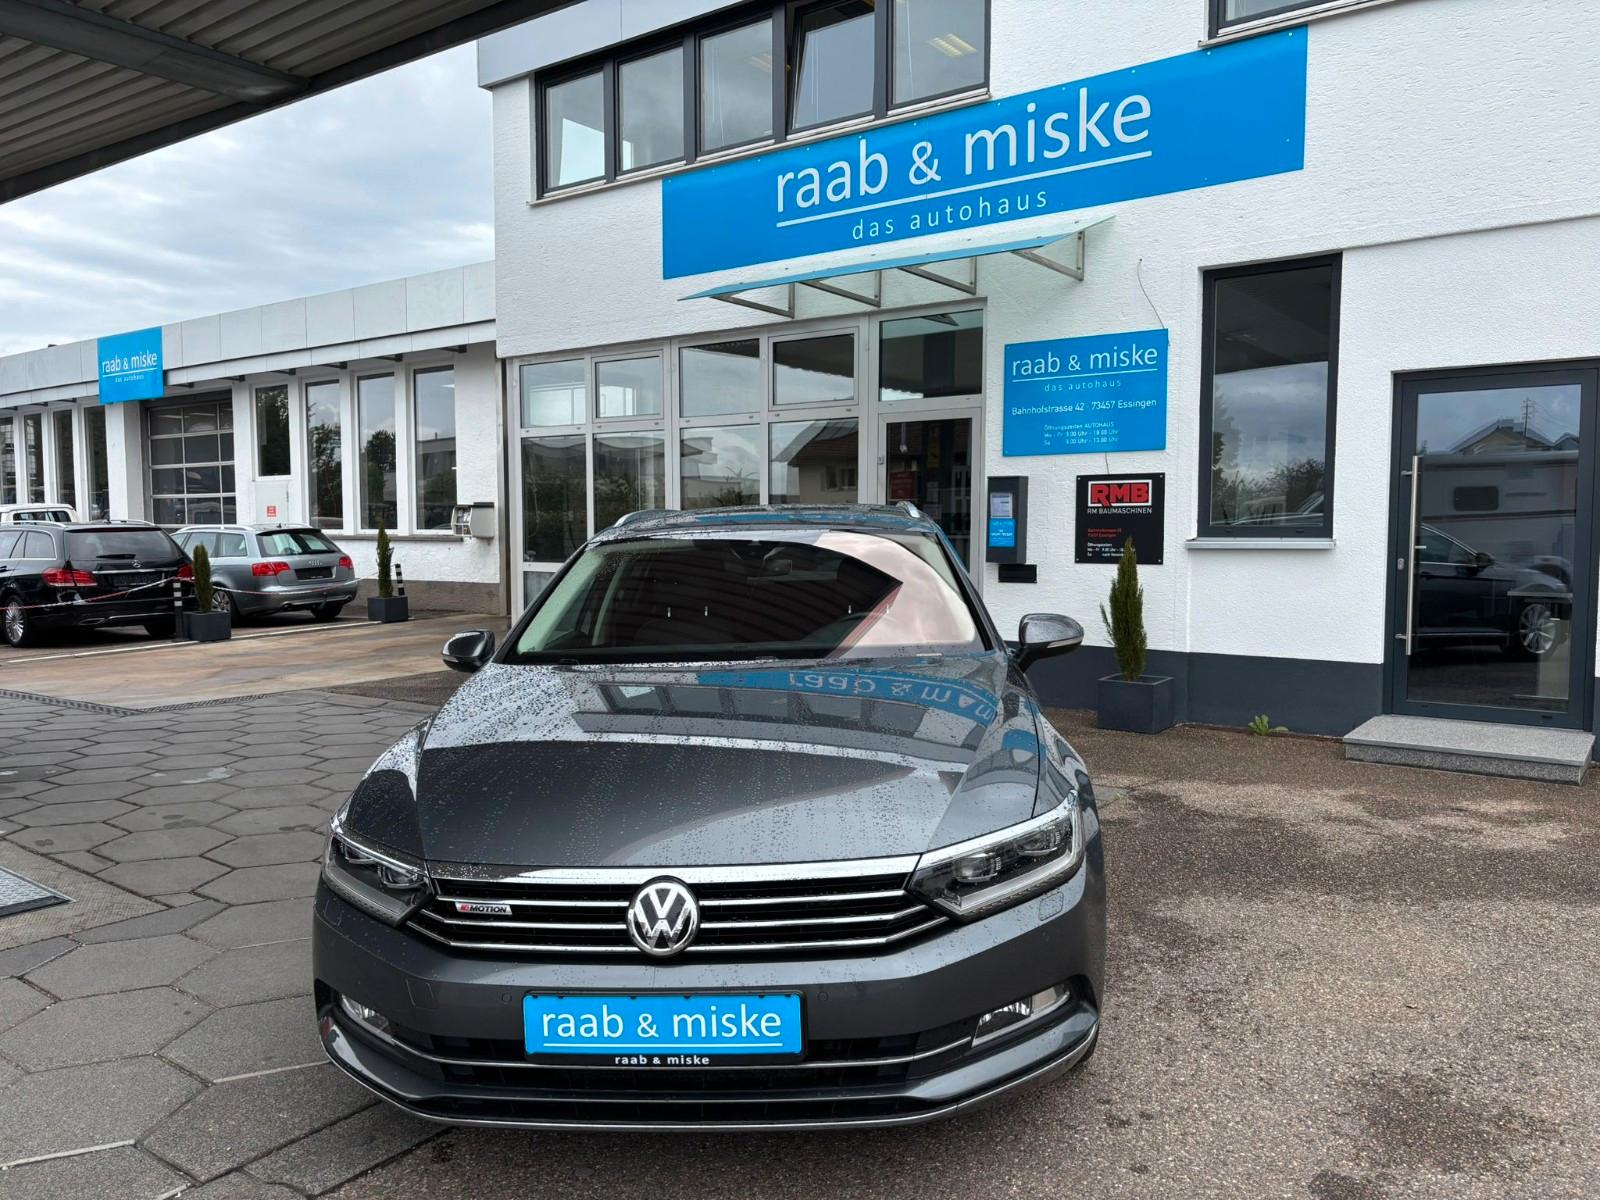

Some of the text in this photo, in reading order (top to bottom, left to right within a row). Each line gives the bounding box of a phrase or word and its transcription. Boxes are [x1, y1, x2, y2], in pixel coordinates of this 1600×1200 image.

[777, 87, 1151, 212] raab & miske
[852, 190, 1047, 241] das autohaus
[102, 349, 158, 373] raab & miske
[1012, 343, 1158, 376] raab & miske
[1044, 379, 1121, 392] das autohaus
[1012, 399, 1157, 416] Bahnhofstrasse 42 73457 Essingen
[1091, 483, 1149, 507] RMB
[542, 1003, 782, 1038] raab & miske
[614, 1054, 710, 1065] raab & miske
